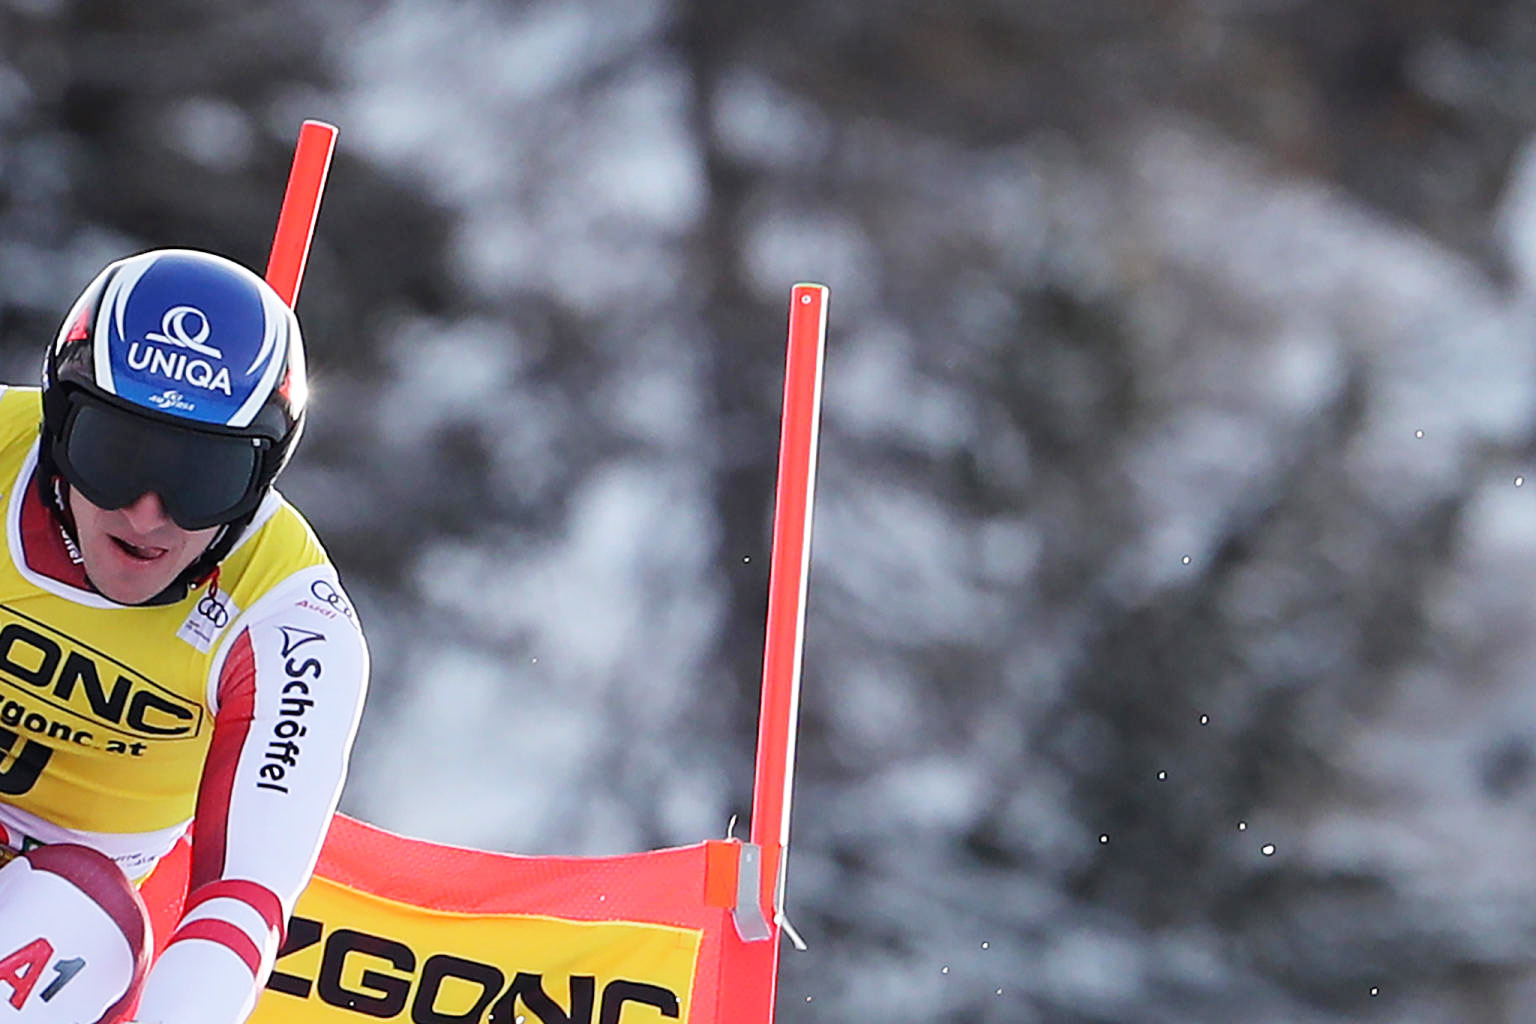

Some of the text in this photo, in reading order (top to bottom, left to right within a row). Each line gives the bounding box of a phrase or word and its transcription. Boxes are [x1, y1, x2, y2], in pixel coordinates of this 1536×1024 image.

[128, 342, 232, 396] UNIQA
[295, 599, 338, 621] Audi
[257, 657, 322, 794] Schöffel
